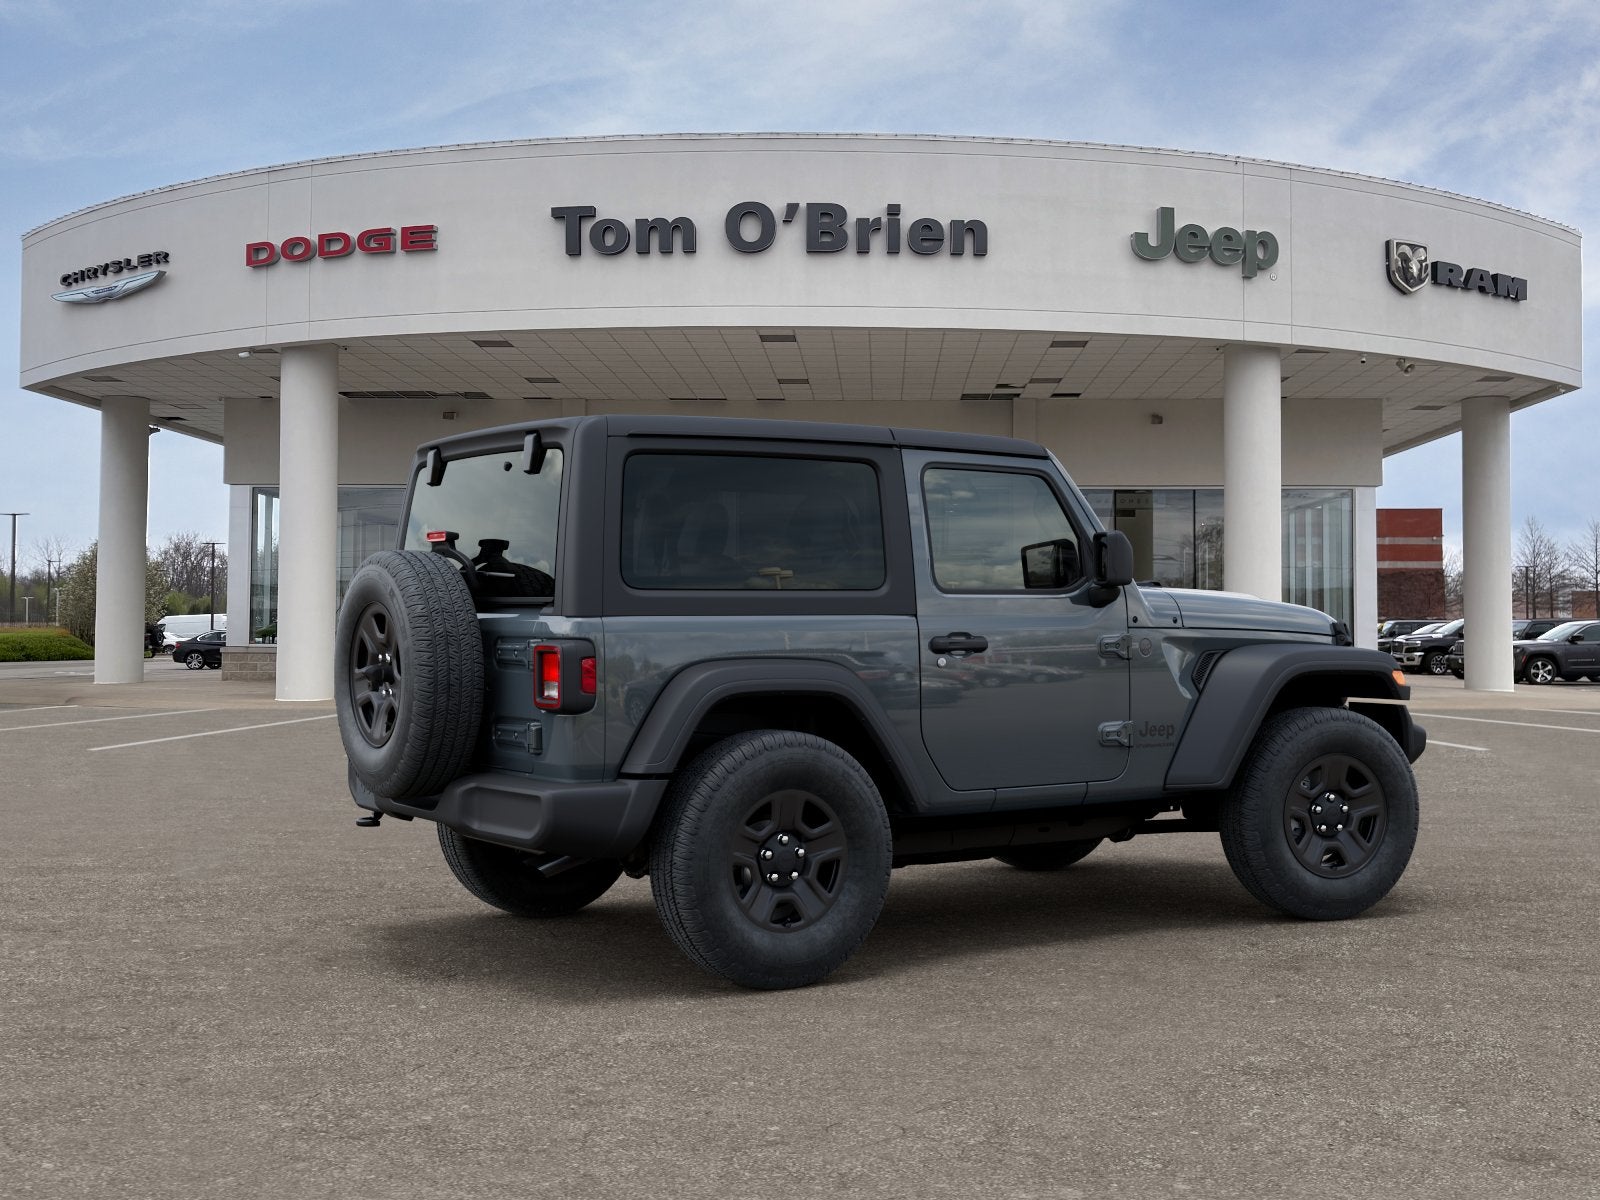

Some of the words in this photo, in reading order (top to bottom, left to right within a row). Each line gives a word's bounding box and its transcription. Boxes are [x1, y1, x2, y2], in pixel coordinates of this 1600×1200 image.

[246, 225, 438, 268] DODGE
[551, 205, 697, 256] Tom
[725, 201, 988, 256] O'Brien
[1131, 207, 1279, 279] Jeep
[60, 251, 169, 287] CHRYSLER
[1431, 261, 1527, 301] RAM
[1139, 721, 1175, 739] Jeep
